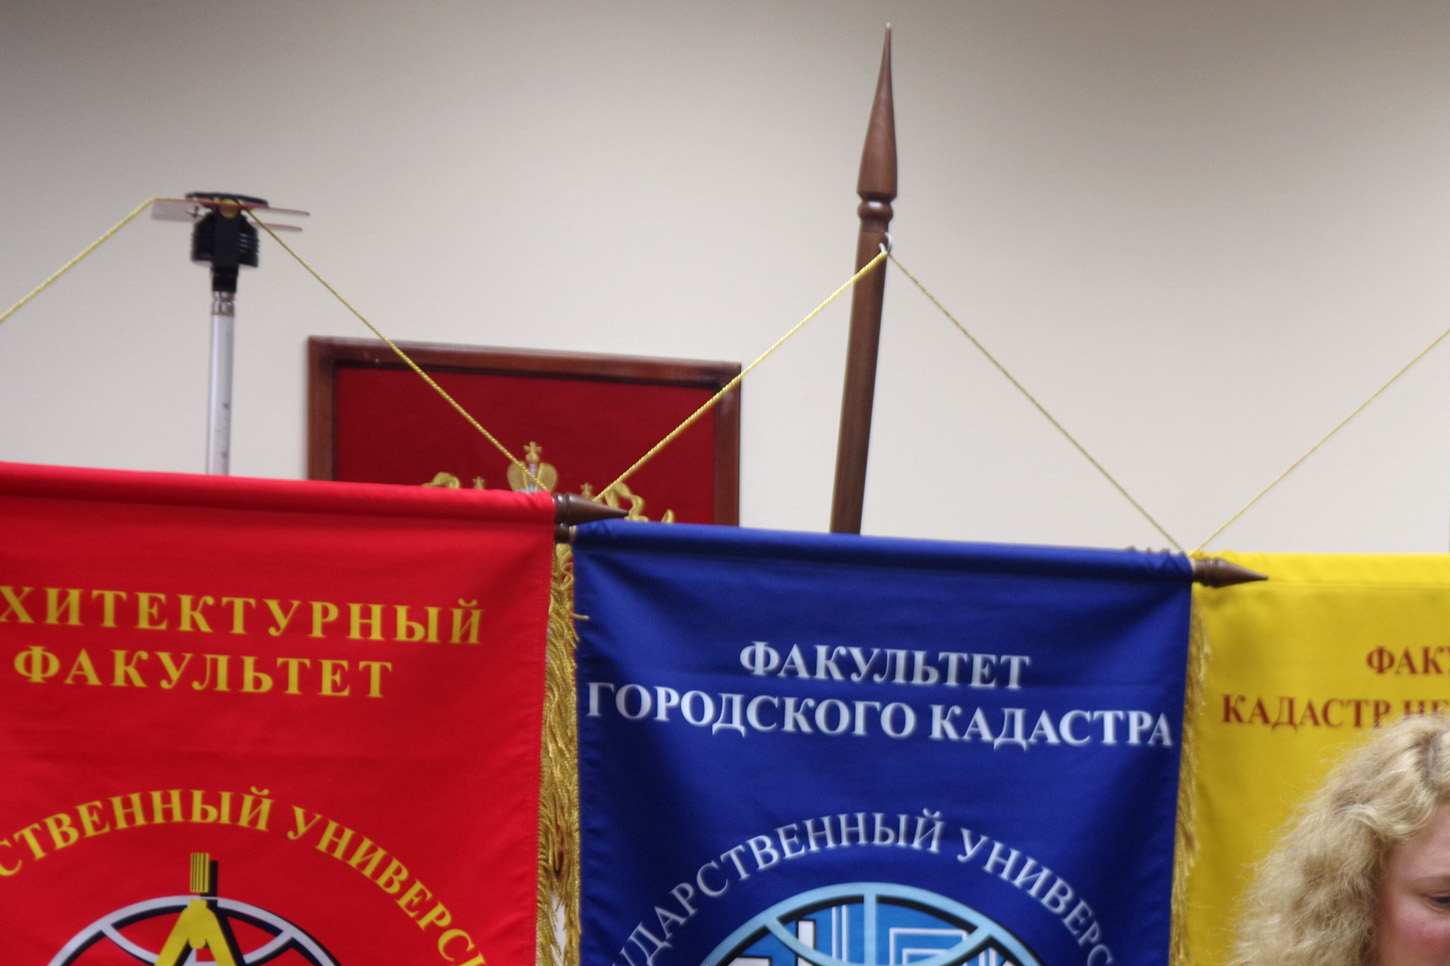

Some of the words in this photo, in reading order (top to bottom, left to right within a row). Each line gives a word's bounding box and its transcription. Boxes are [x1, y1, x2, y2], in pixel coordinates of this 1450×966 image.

[0, 585, 484, 645] ХИТЕКТУРНЫЙ
[14, 645, 392, 698] ФАКУЛЬТЕТ
[740, 640, 1030, 690] ФАКУЛЬТЕТ
[587, 682, 915, 738] ГОРОДСКОГО
[930, 704, 1173, 750] КАДАСТРА
[1221, 693, 1391, 731] КАДАСТР
